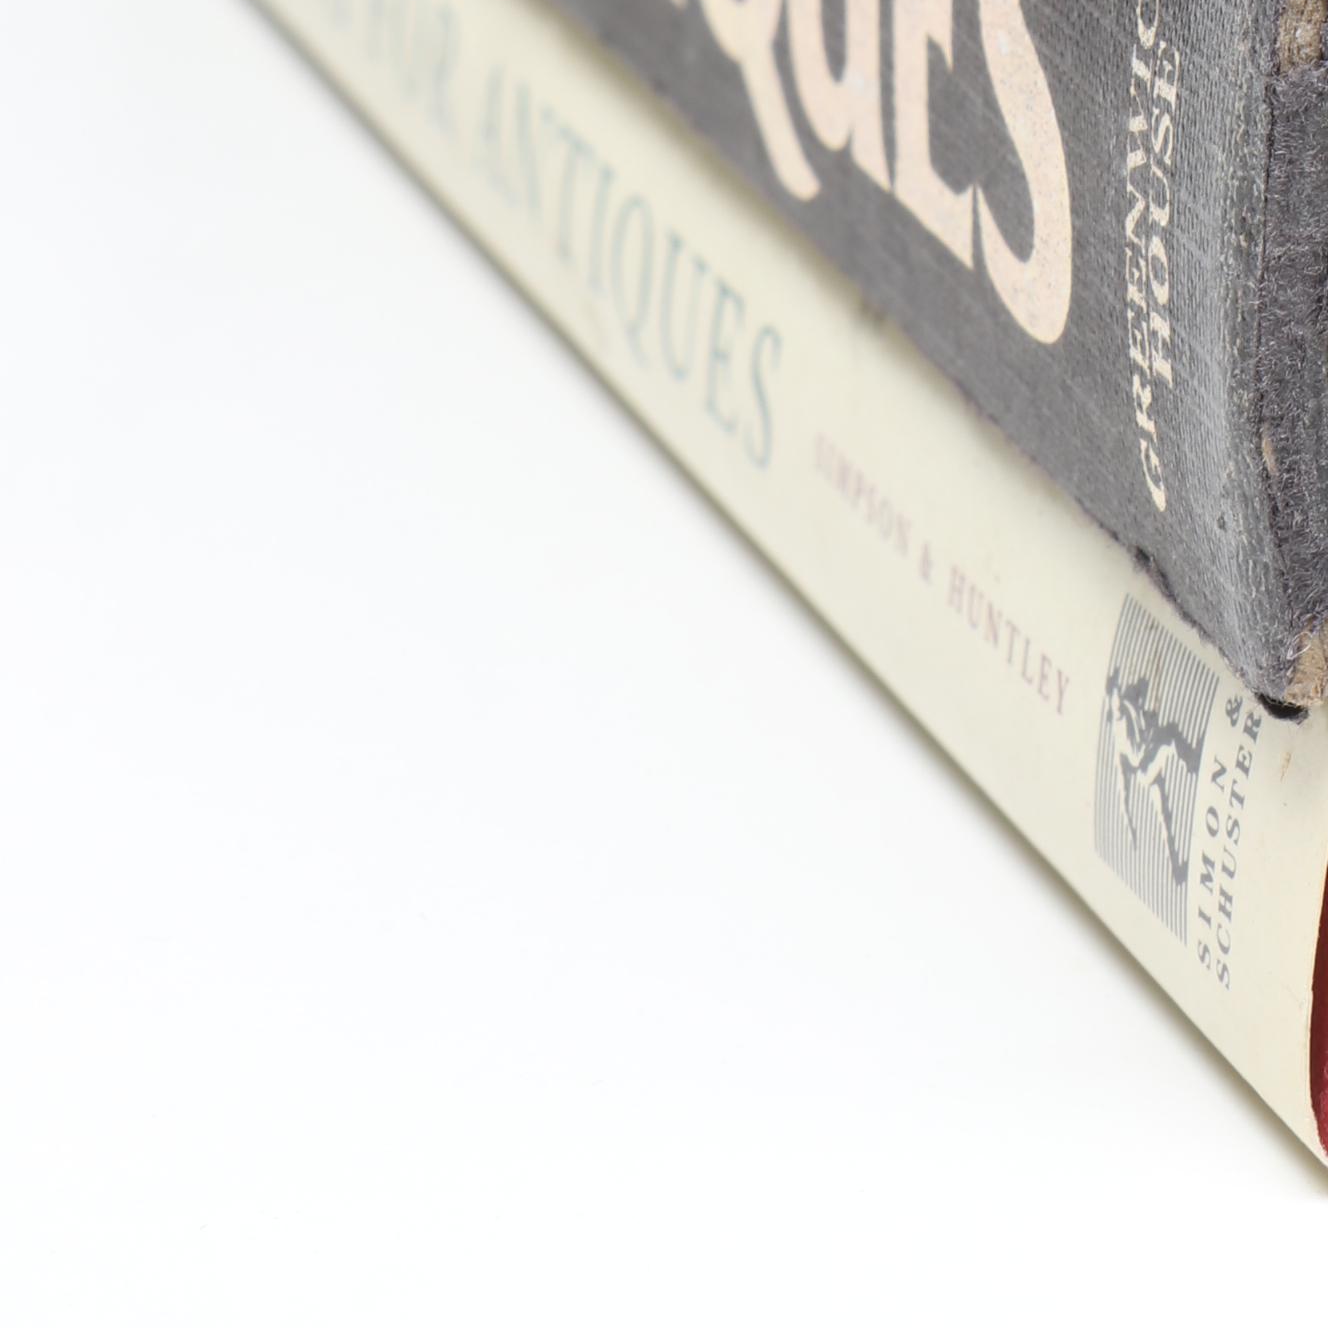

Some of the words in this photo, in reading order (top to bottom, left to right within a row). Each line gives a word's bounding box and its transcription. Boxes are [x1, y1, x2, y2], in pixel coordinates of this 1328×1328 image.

[474, 58, 784, 471] ANTIQUES
[1148, 40, 1181, 391] HOUSE
[948, 564, 1070, 716] HUNTLEY
[1196, 755, 1228, 973] SIMON
[1224, 693, 1244, 728] &
[1215, 711, 1263, 992] SCHUSTER
